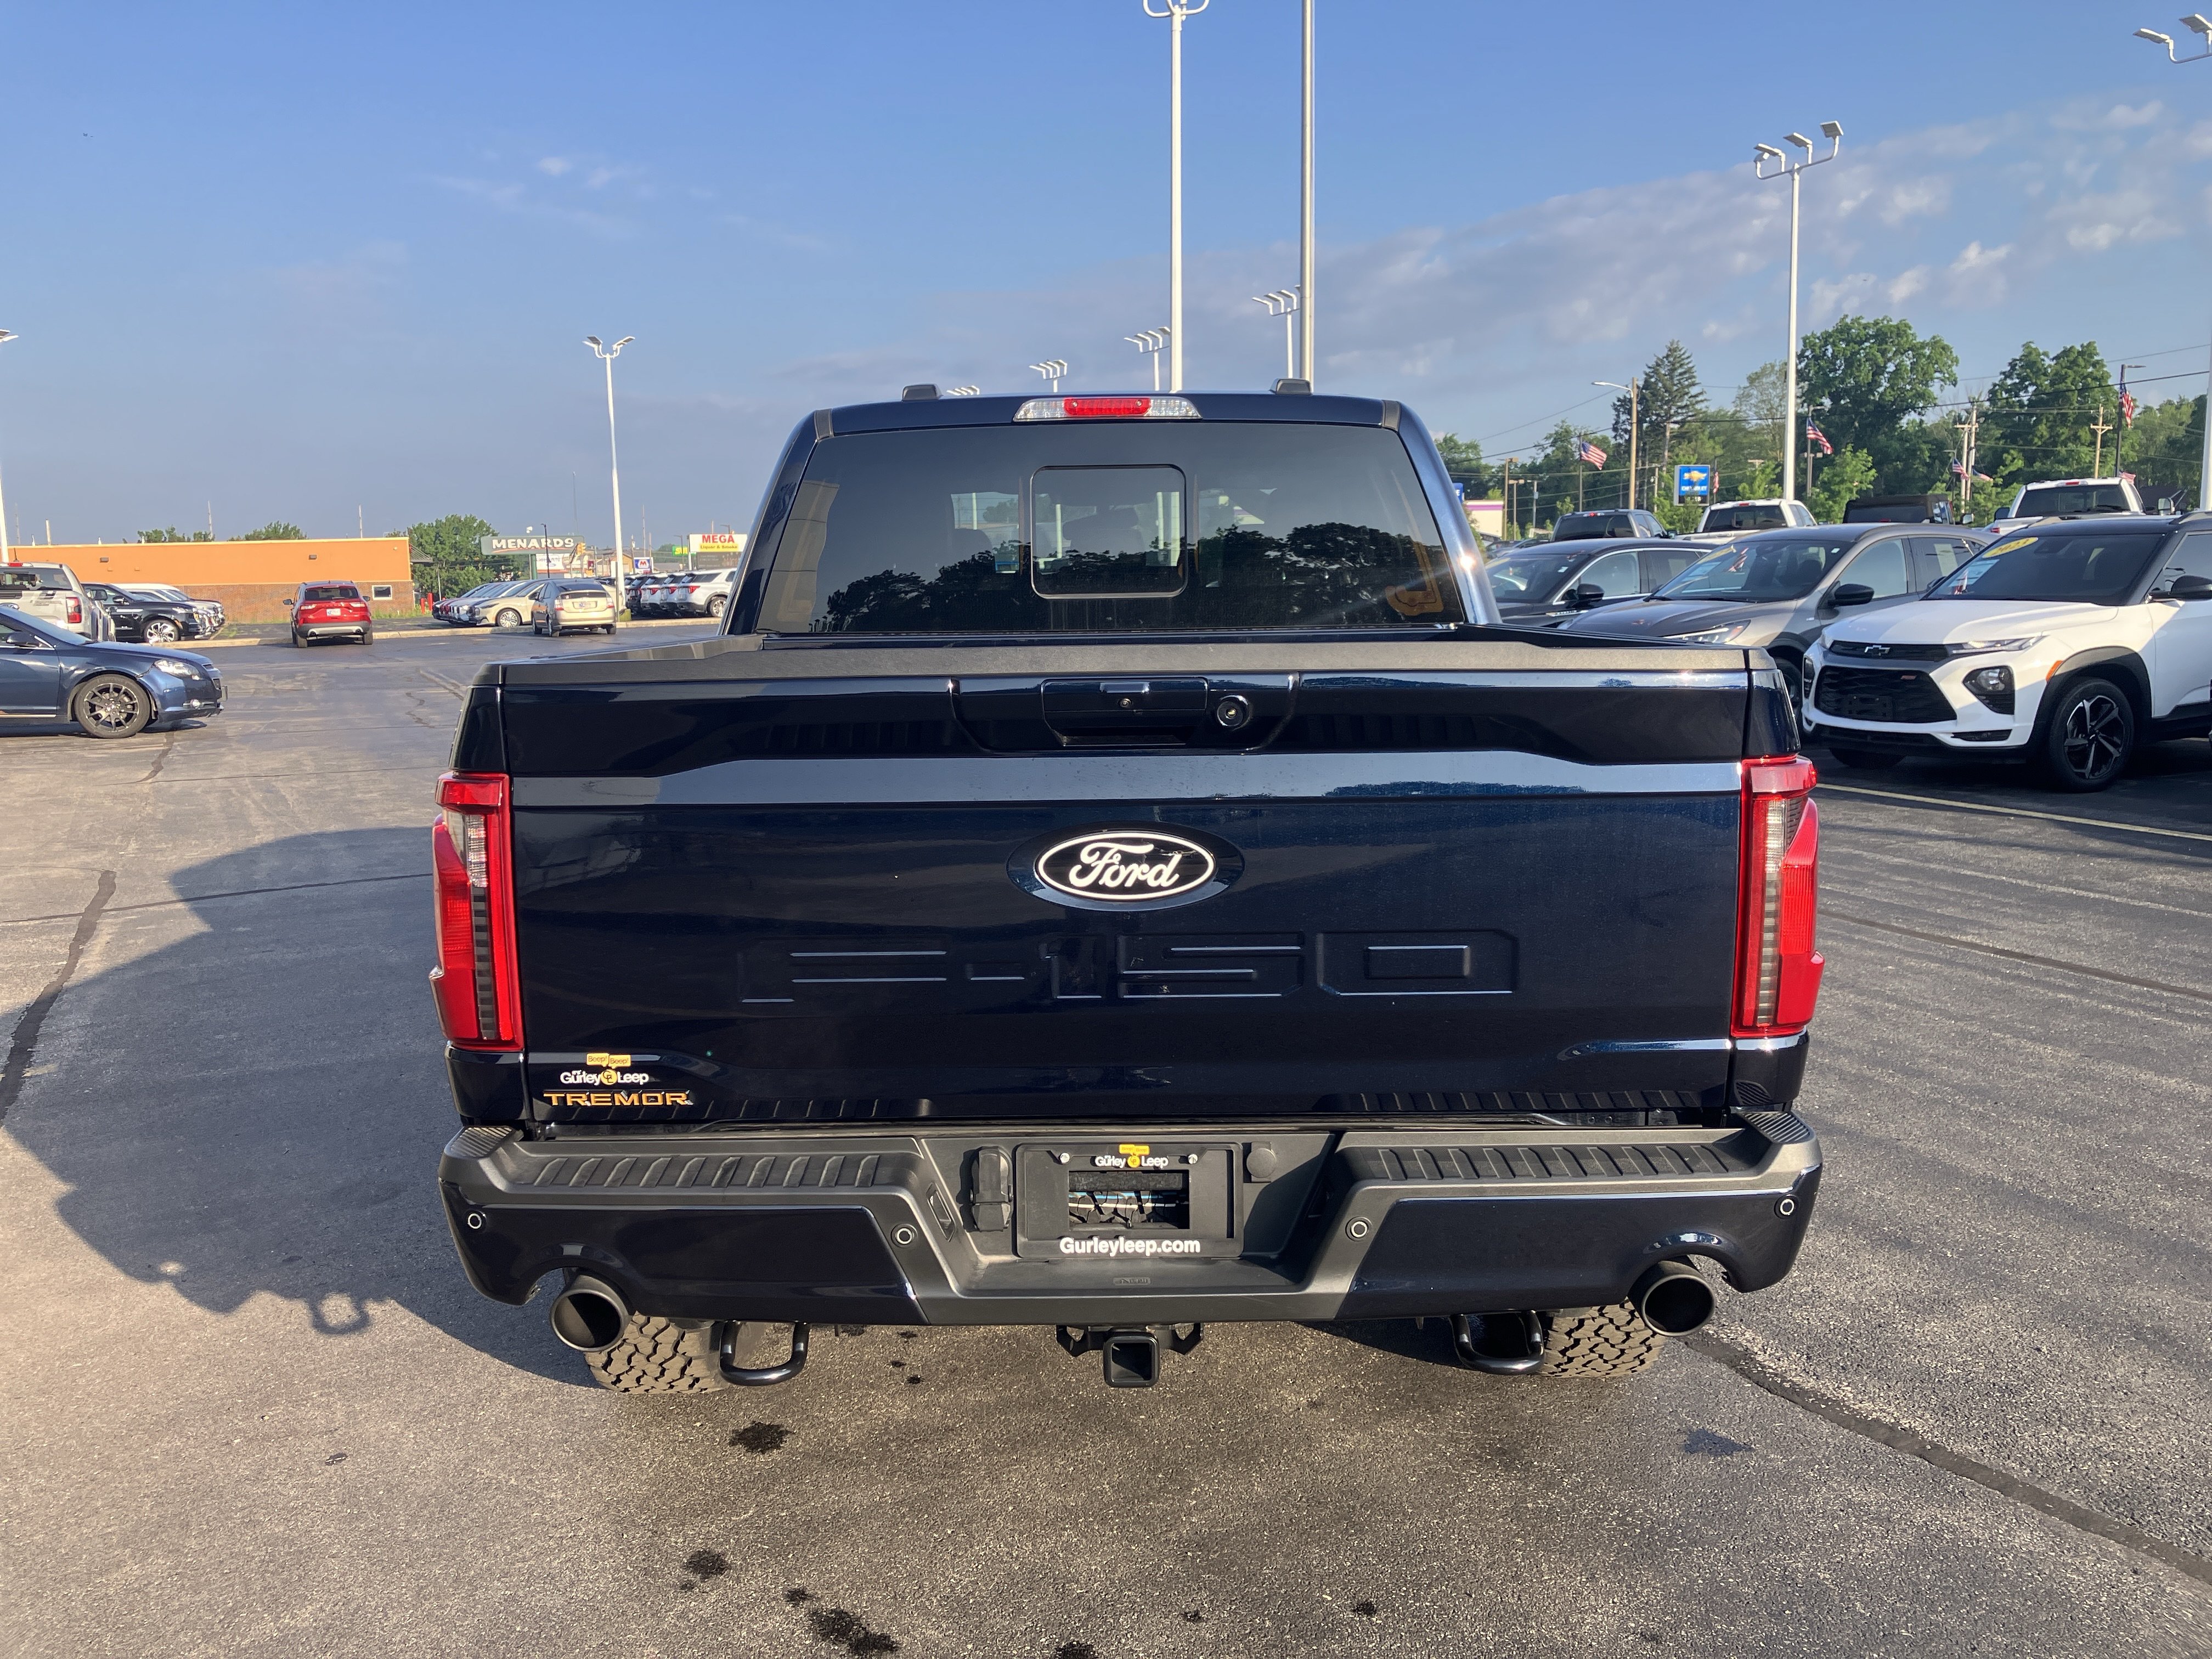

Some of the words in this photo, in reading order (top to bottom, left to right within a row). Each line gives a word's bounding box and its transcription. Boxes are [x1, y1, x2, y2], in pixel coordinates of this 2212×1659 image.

[492, 538, 574, 549] MENARDS
[702, 535, 735, 543] MEGA
[1069, 842, 1183, 888] Ford
[560, 1071, 601, 1086] Gurley
[617, 1071, 649, 1085] Leep
[543, 1092, 693, 1106] TREMOR
[1095, 1155, 1126, 1168] Gurley
[1141, 1155, 1169, 1169] Leep
[1059, 1236, 1201, 1257] Gurleyleep.com
